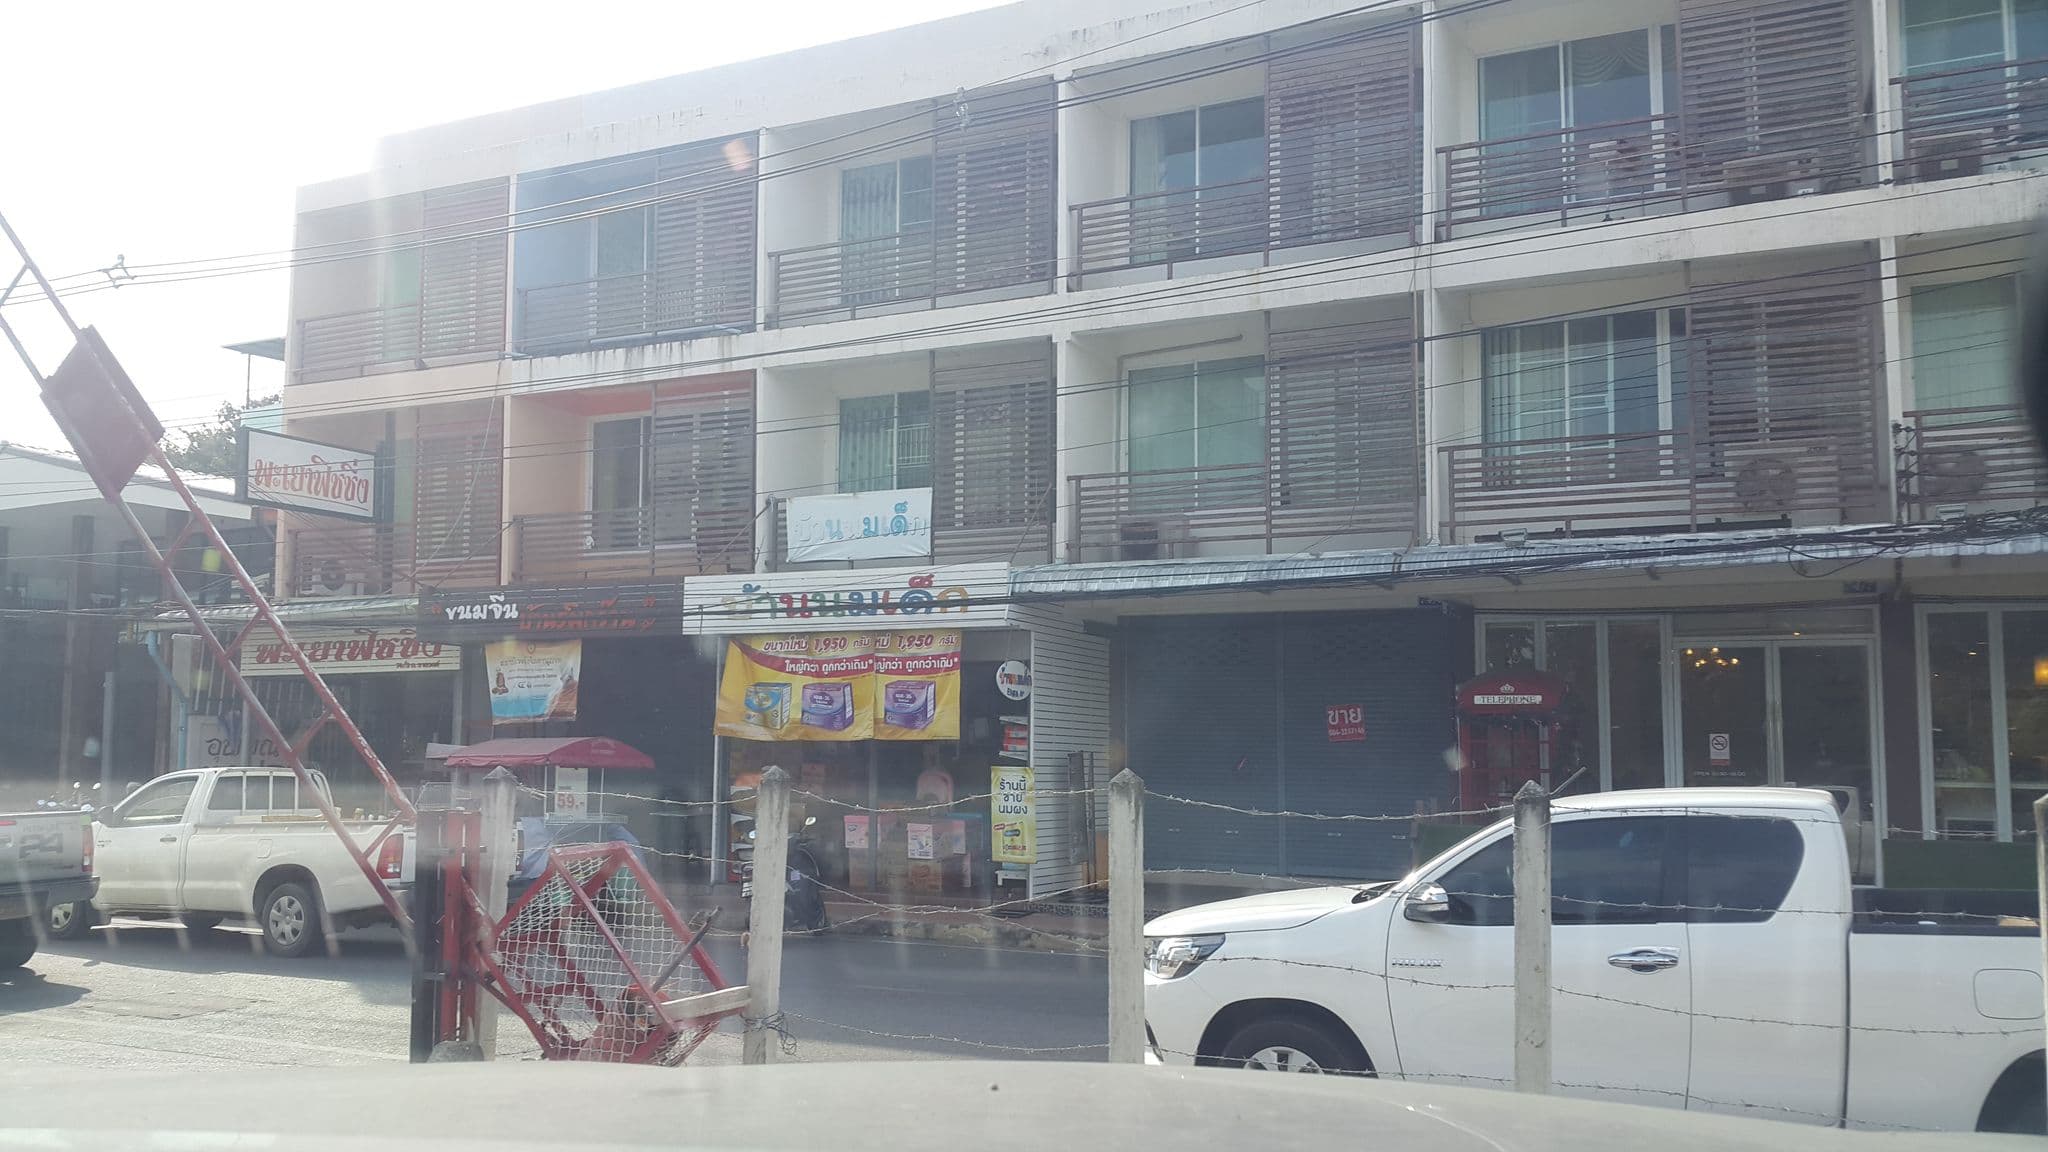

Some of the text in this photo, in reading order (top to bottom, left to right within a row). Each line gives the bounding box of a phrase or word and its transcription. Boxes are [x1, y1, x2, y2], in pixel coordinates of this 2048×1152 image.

[721, 573, 969, 620] บ้านนมเด็ก
[445, 594, 518, 621] ขนมจีน
[814, 636, 848, 652] 1,950
[897, 634, 934, 650] 1,950
[1480, 696, 1538, 704] TELEPHONE
[1328, 708, 1362, 725] ขาย
[1000, 776, 1027, 791] ร้านนี้
[1003, 793, 1023, 803] ขาย
[999, 805, 1028, 815] นมผง
